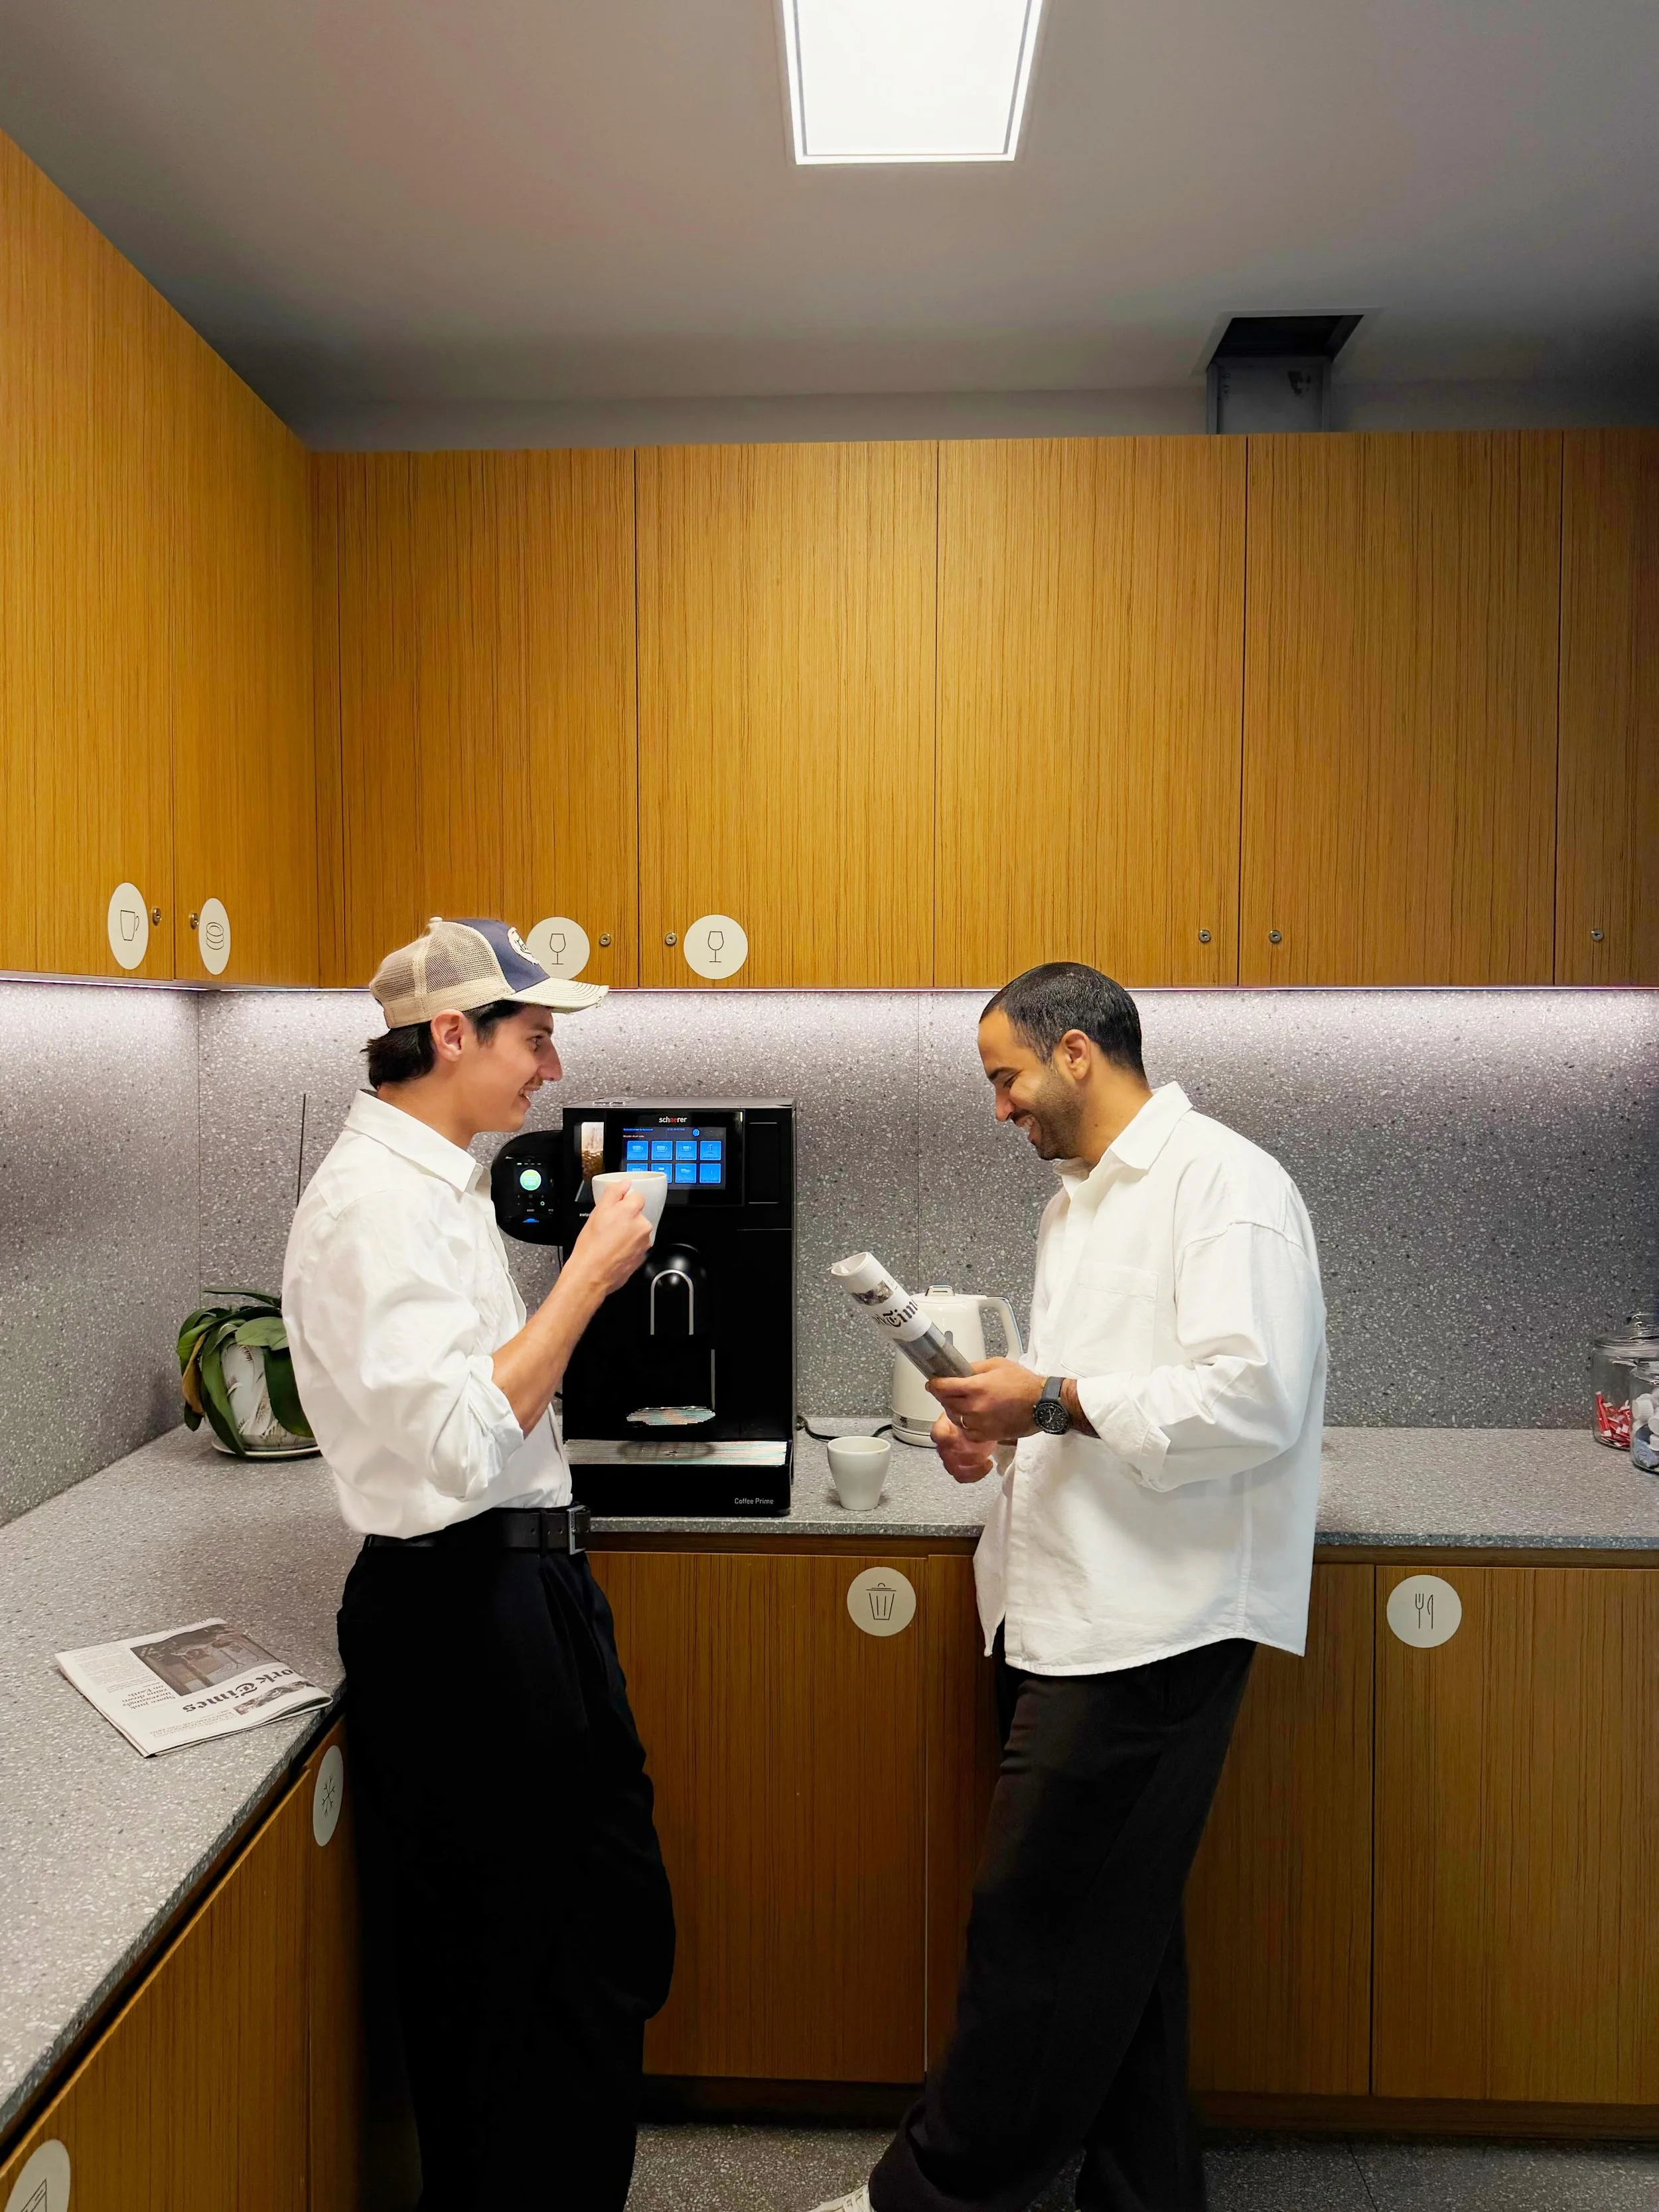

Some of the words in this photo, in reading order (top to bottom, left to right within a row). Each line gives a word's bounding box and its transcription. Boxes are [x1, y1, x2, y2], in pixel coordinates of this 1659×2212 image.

[883, 1299, 918, 1327] Tim
[255, 1668, 294, 1684] ork
[182, 1682, 258, 1712] Times
